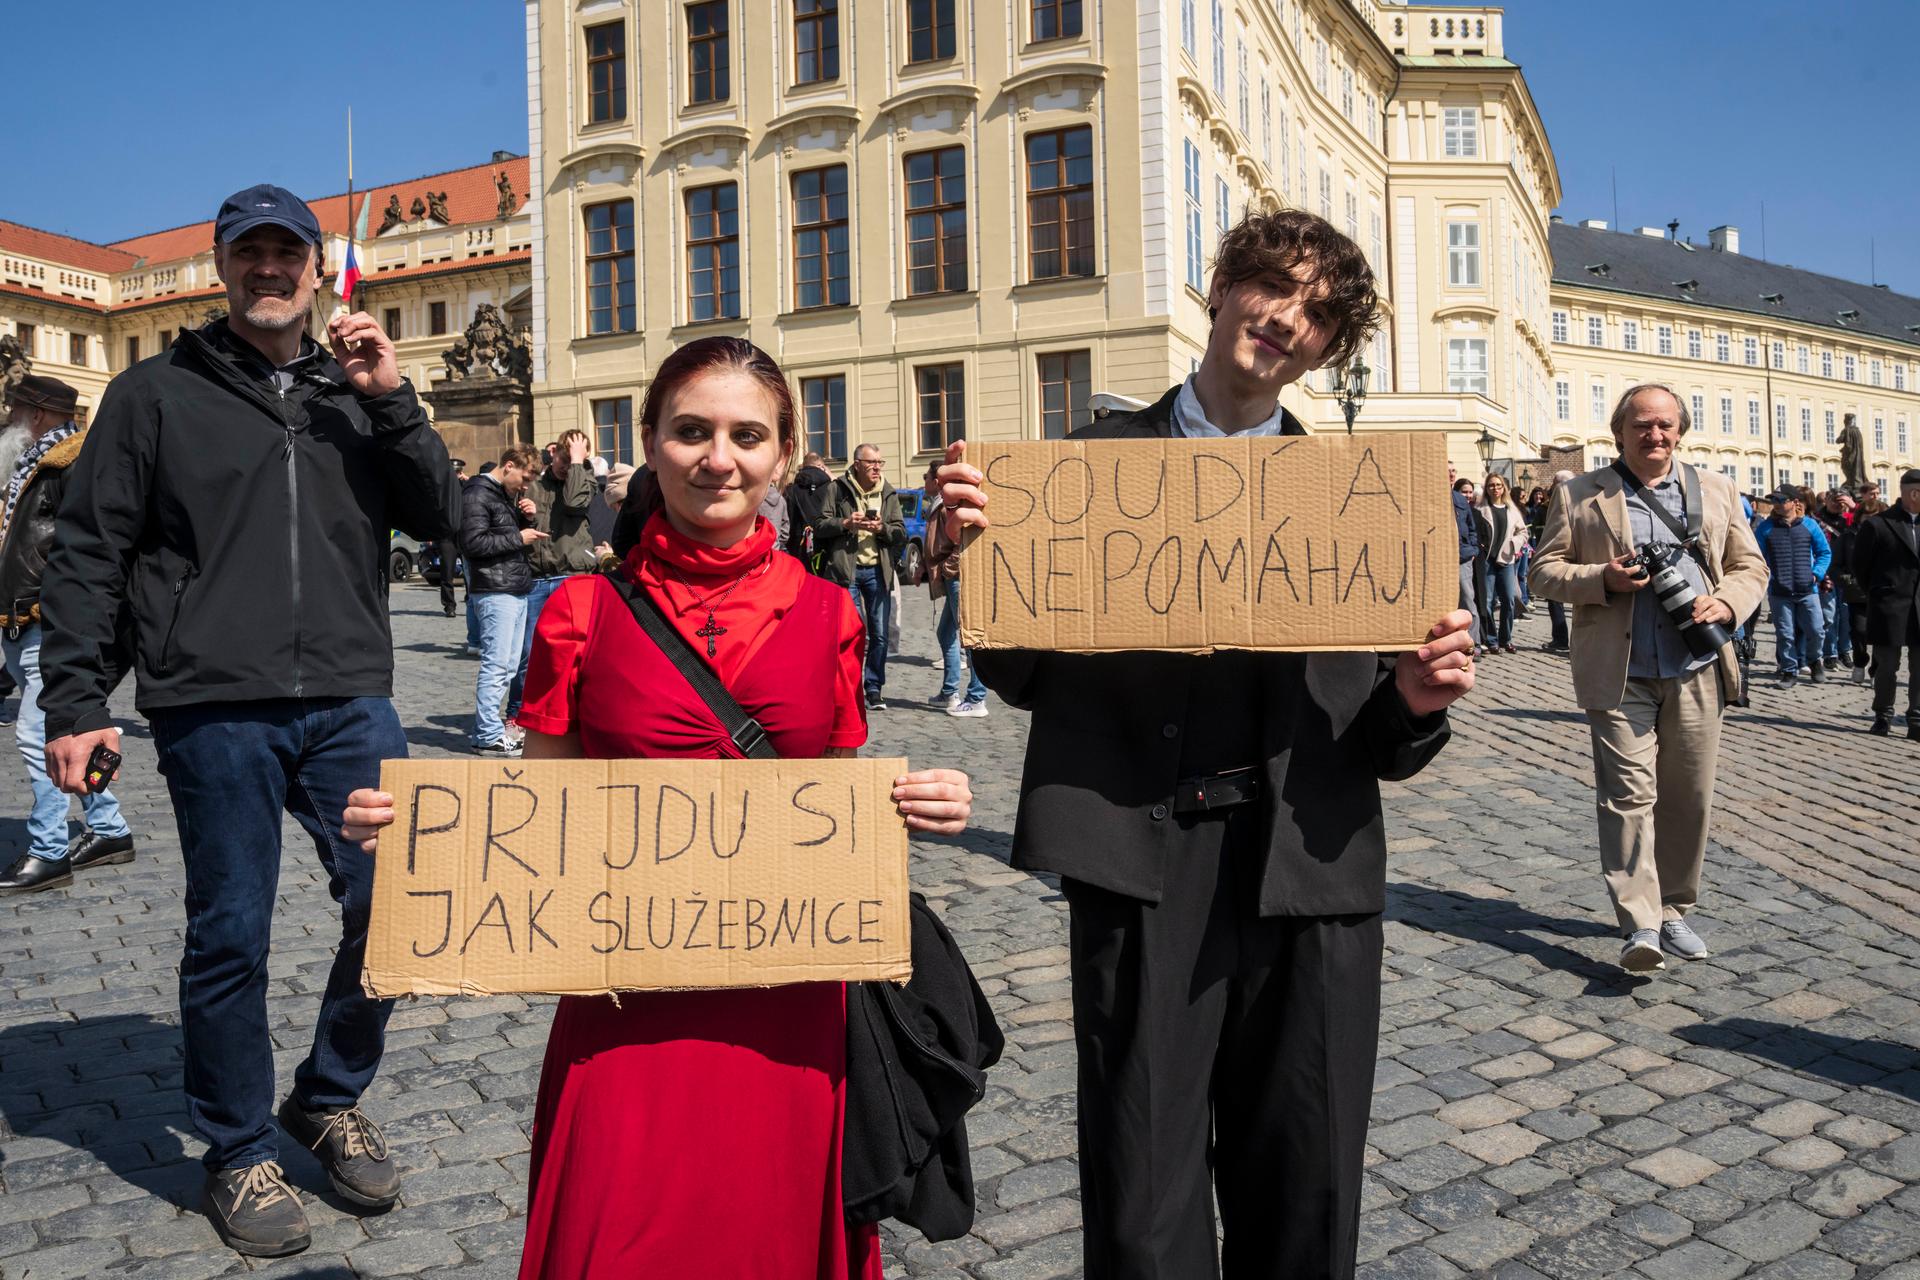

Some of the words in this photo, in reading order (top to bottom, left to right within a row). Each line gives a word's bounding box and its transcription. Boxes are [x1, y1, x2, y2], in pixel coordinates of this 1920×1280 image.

[986, 440, 1299, 527] SOUDÍ
[1338, 447, 1402, 516] A
[991, 516, 1436, 624] NEPOMÁHAJÍ
[406, 766, 749, 882] PŘIJDU
[792, 782, 856, 854] SI
[406, 889, 558, 957] JAK
[588, 890, 884, 954] SLUŽEBNICE
